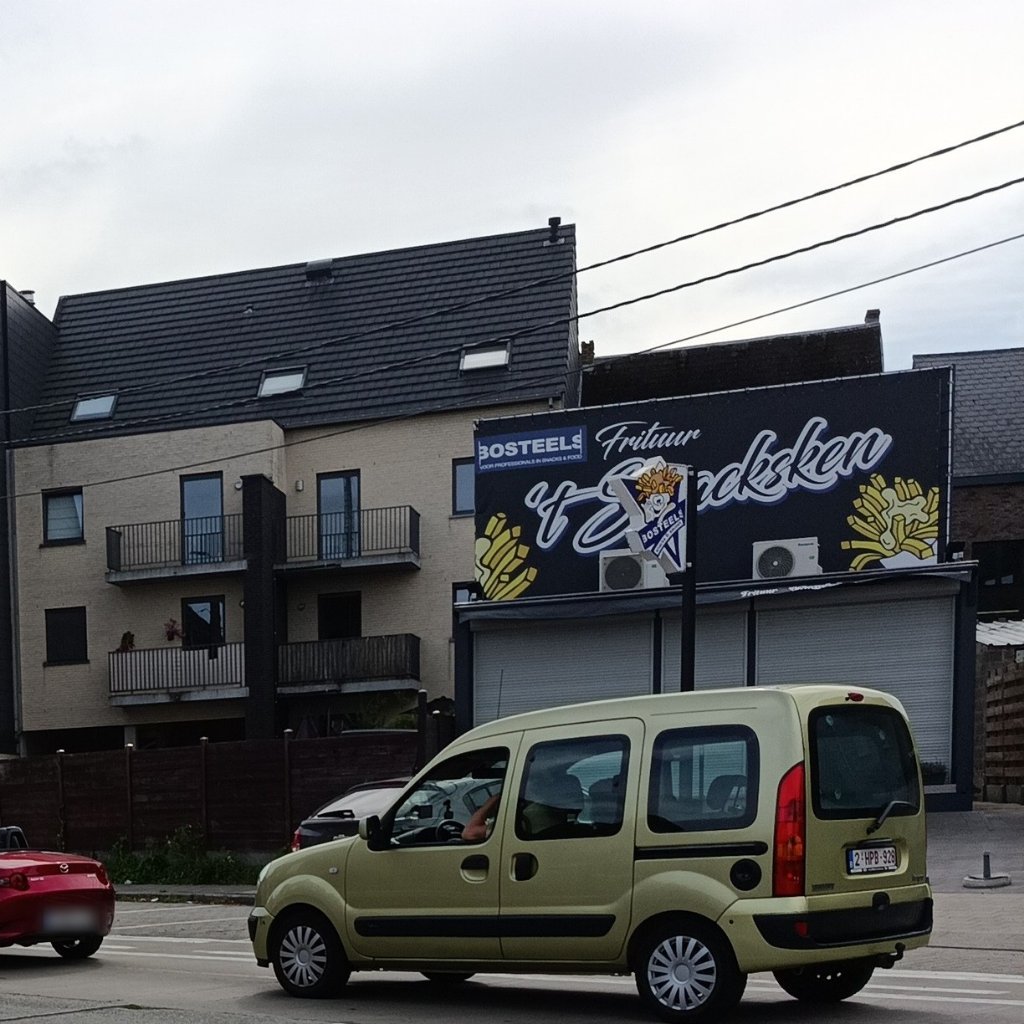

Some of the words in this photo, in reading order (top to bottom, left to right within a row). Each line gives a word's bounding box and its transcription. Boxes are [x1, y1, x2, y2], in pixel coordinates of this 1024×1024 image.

[479, 433, 582, 461] BOSTEELS
[595, 420, 703, 461] Frituur
[573, 416, 892, 554] Sacksken
[641, 508, 684, 544] BOSTEELS
